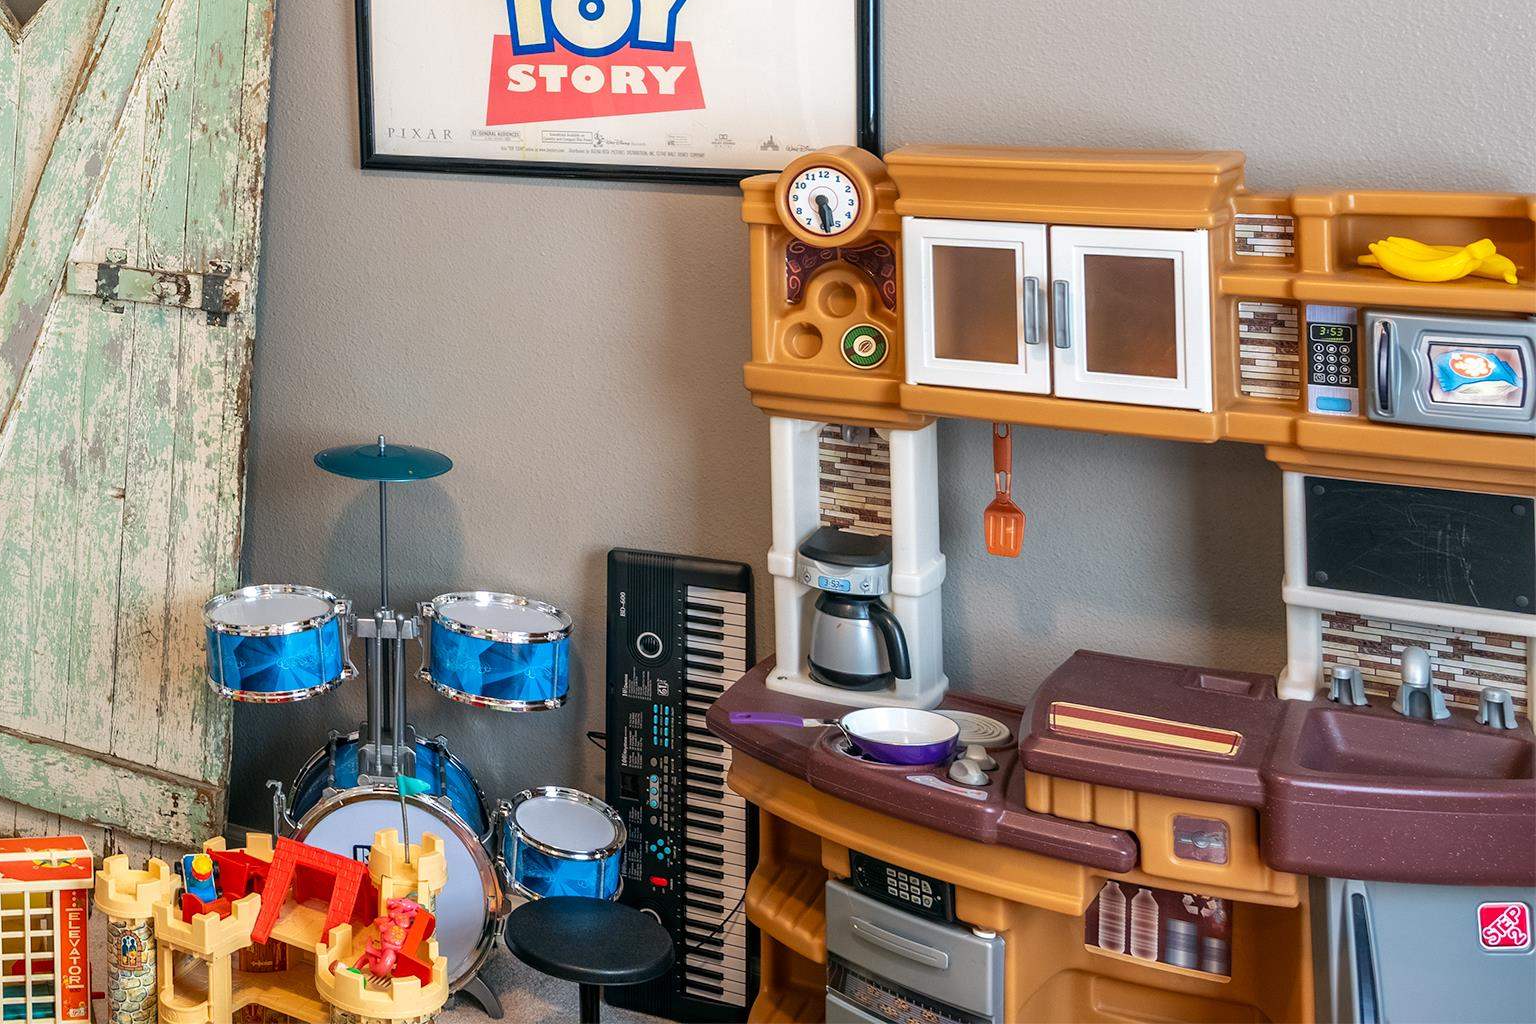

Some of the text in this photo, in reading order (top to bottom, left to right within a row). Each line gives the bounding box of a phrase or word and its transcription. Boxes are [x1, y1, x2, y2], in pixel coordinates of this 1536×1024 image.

[506, 63, 687, 95] STORY
[388, 127, 454, 140] PIXAR
[796, 207, 802, 215] 8
[845, 211, 851, 219] 4
[1319, 326, 1344, 337] 3:53
[1482, 905, 1527, 945] STEP 2
[68, 912, 82, 985] ELEVATOR
